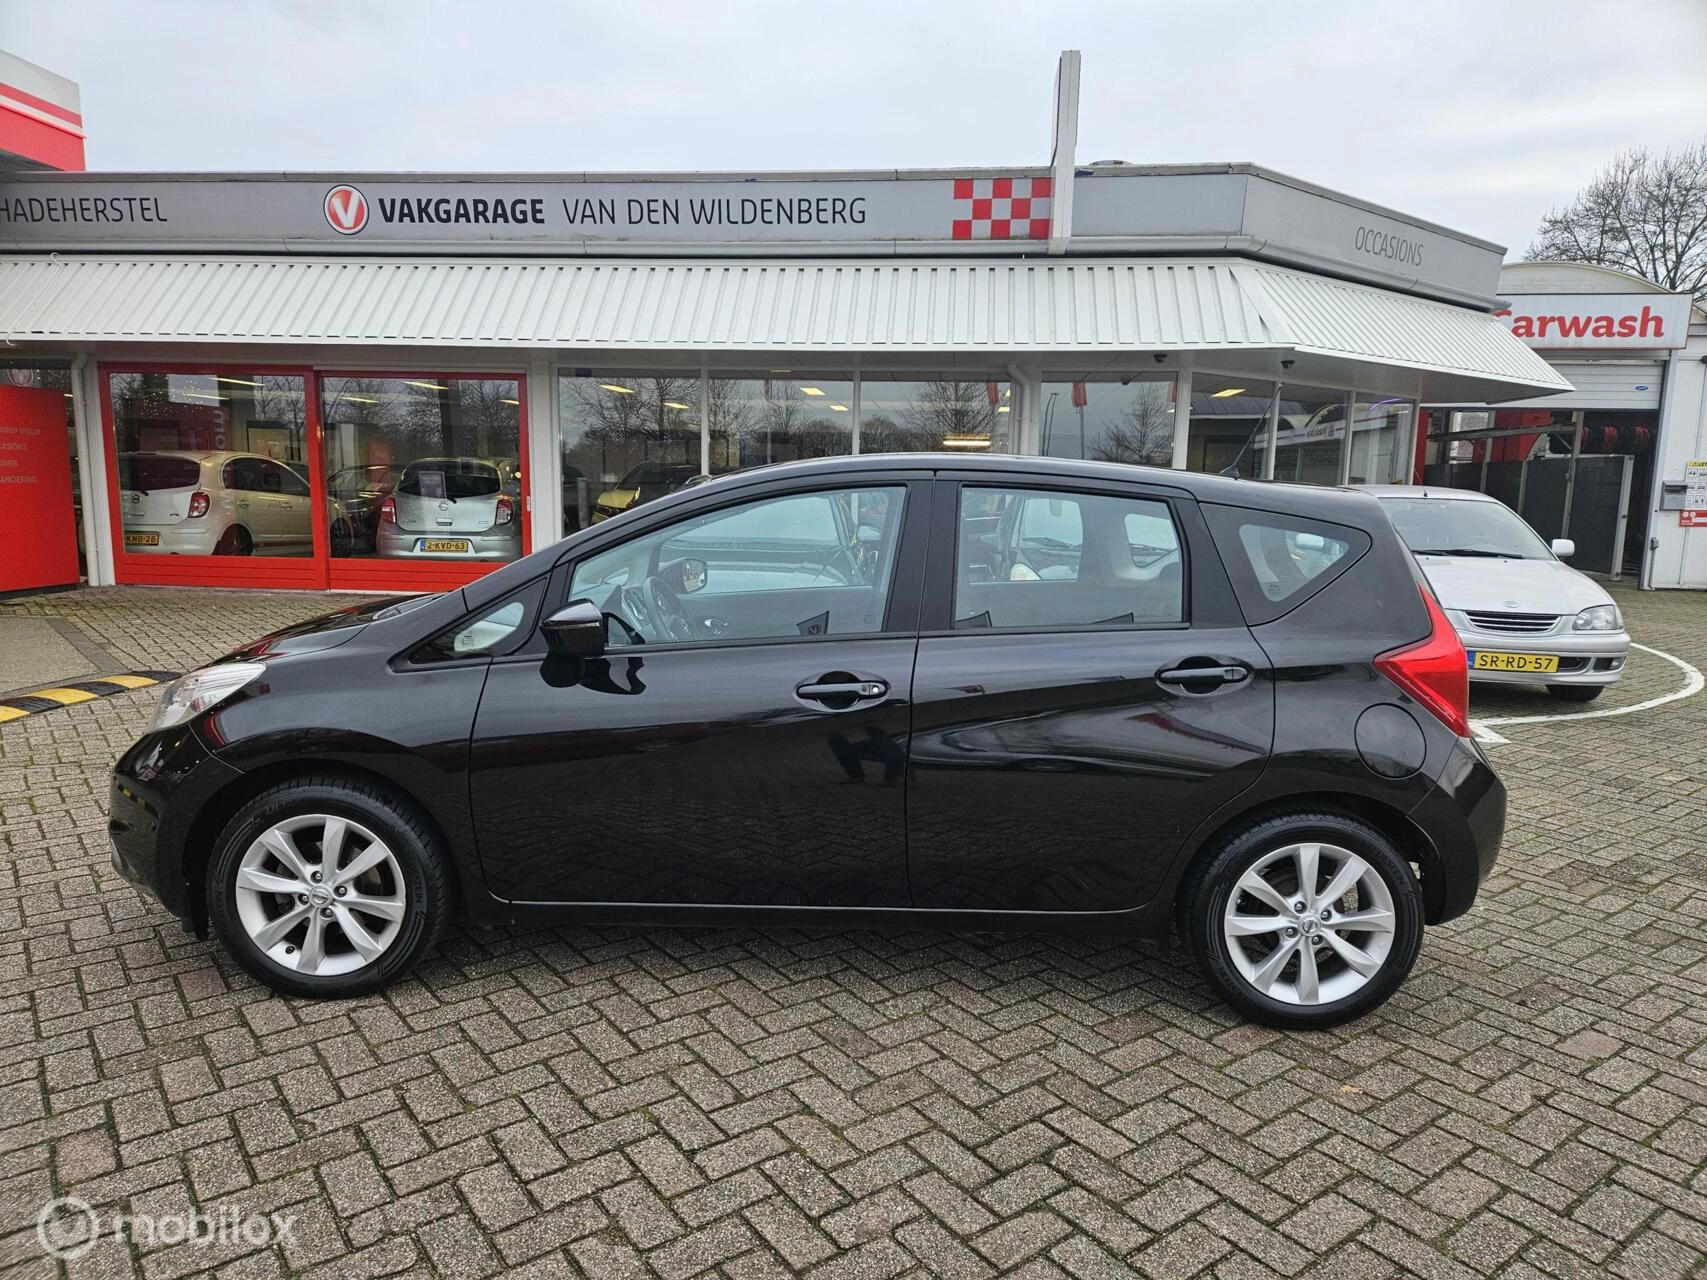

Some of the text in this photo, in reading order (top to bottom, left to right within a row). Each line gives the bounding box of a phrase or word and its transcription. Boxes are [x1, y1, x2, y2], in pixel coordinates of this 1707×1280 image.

[378, 197, 866, 225] VAKGARAGE VAN DEN WILDENBERG
[1355, 226, 1424, 267] OCCASIONS
[1494, 305, 1665, 338] arwash
[427, 541, 465, 550] 2-KVD-63
[1479, 654, 1554, 670] SR-RD-57
